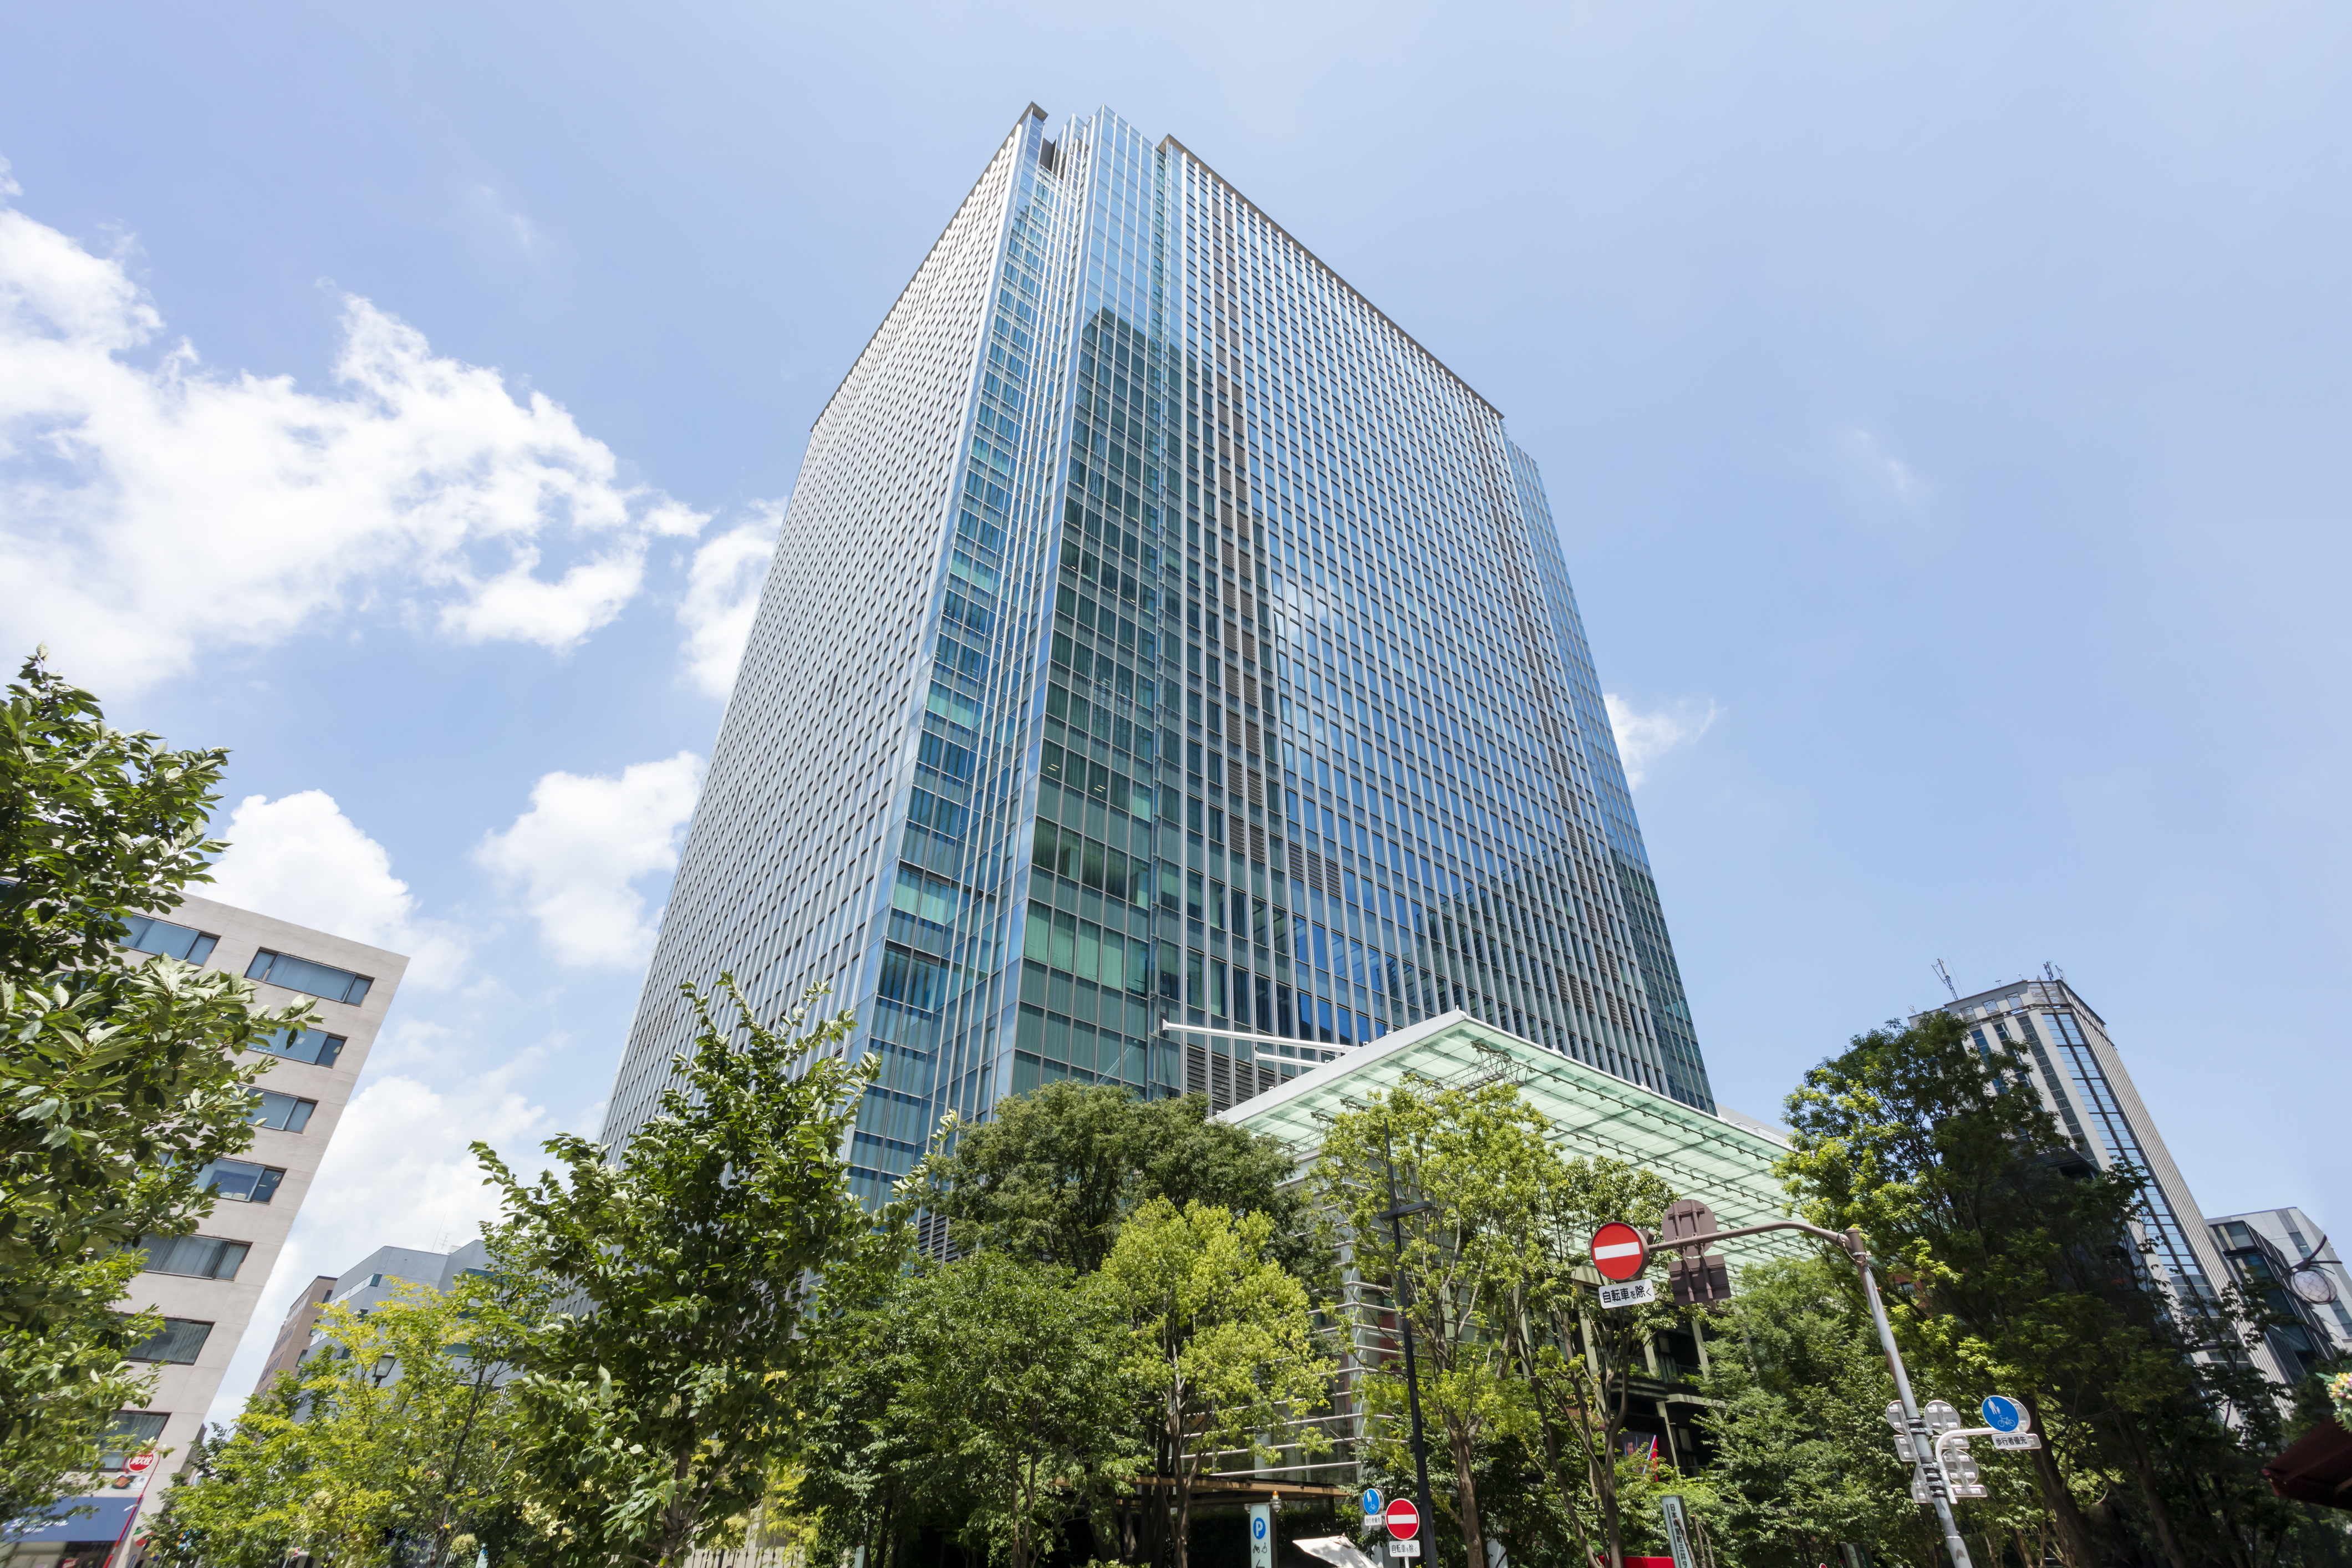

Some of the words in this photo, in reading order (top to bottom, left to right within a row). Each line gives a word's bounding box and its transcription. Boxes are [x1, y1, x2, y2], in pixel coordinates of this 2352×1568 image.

[1602, 1285, 1652, 1304] 自転車を除く
[1995, 1435, 2028, 1446] 歩行者優先
[130, 1455, 153, 1465] 消火栓
[1256, 1521, 1263, 1536] P
[1670, 1504, 1688, 1568] 日本室町三井タ
[1392, 1544, 1417, 1553] 自転車を除く
